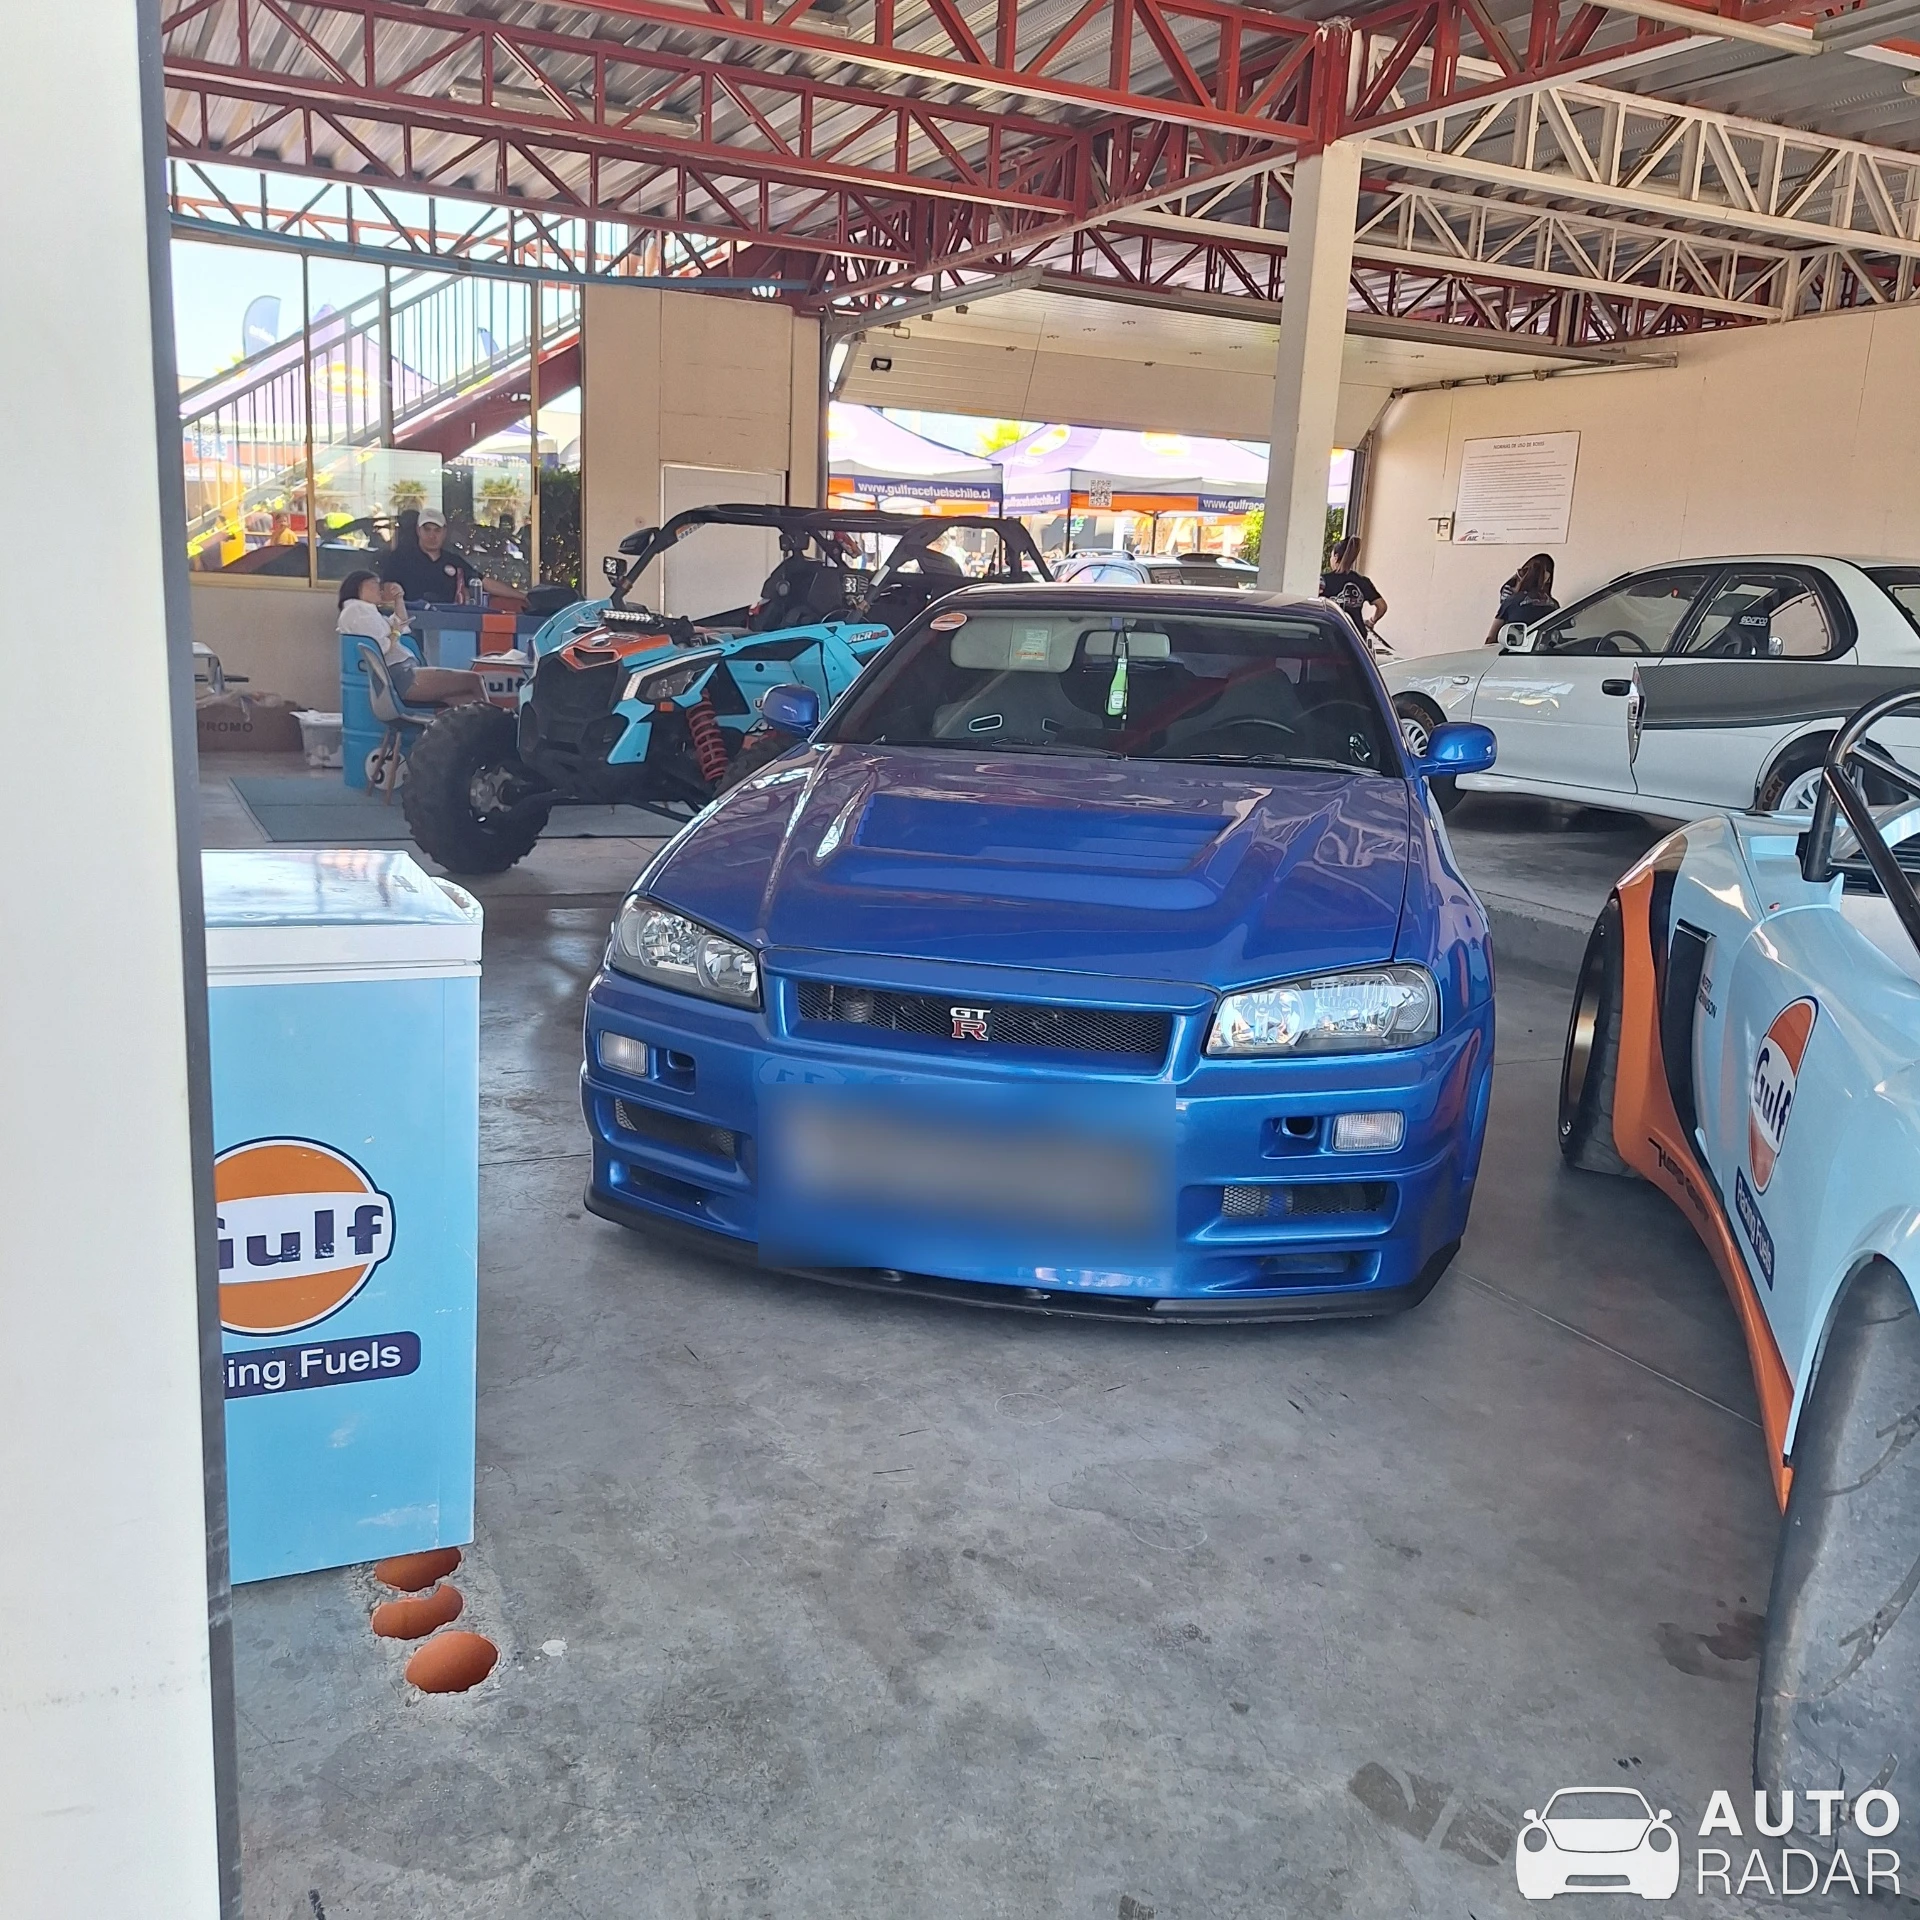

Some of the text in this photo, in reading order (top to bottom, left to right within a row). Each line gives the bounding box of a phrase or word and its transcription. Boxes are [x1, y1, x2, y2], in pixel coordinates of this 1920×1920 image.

[857, 482, 991, 499] www.gulfracefuelschile.cl
[489, 677, 526, 693] ulf
[950, 1007, 993, 1020] GT
[951, 1018, 989, 1041] R
[1754, 1047, 1792, 1144] Gulf
[1737, 1175, 1772, 1276] Racing Fuels
[224, 1342, 402, 1391] ing Fuels
